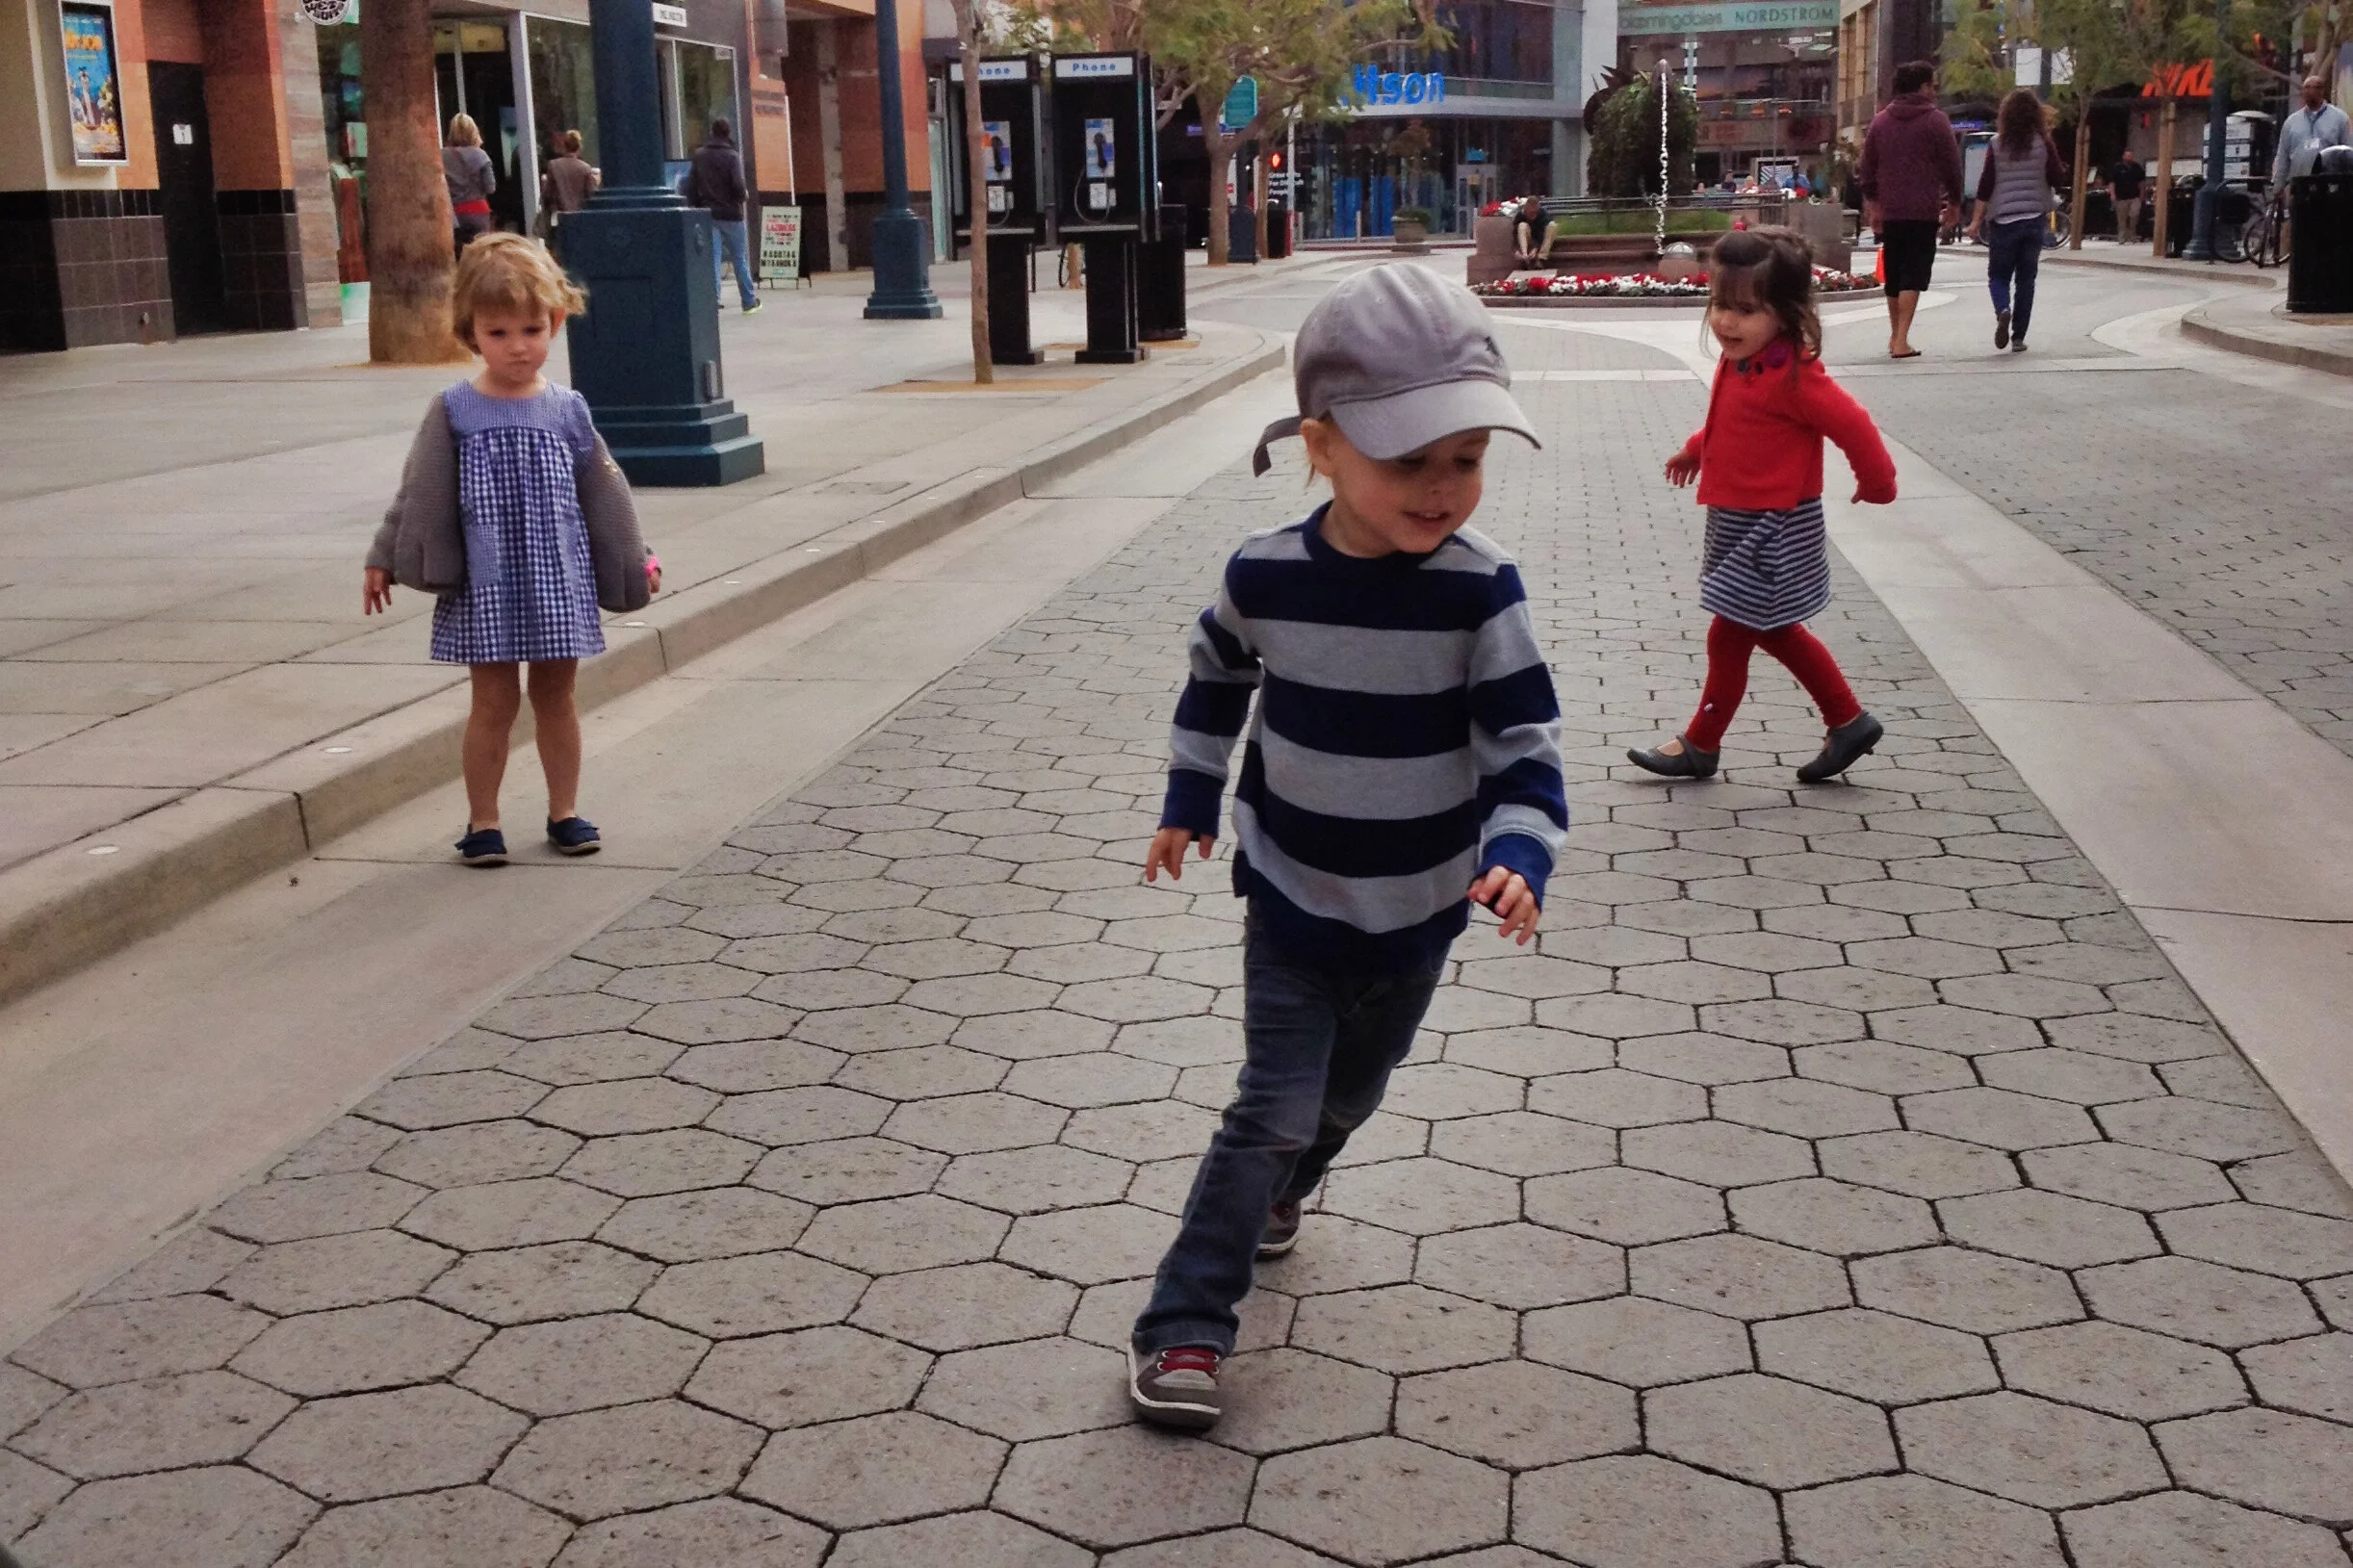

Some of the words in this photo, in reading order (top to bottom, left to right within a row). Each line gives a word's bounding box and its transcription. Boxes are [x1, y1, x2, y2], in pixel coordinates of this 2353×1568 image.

[1735, 8, 1834, 24] NORDSTROM
[978, 67, 1010, 76] hone
[1073, 63, 1116, 72] Phone
[1337, 63, 1445, 106] itson
